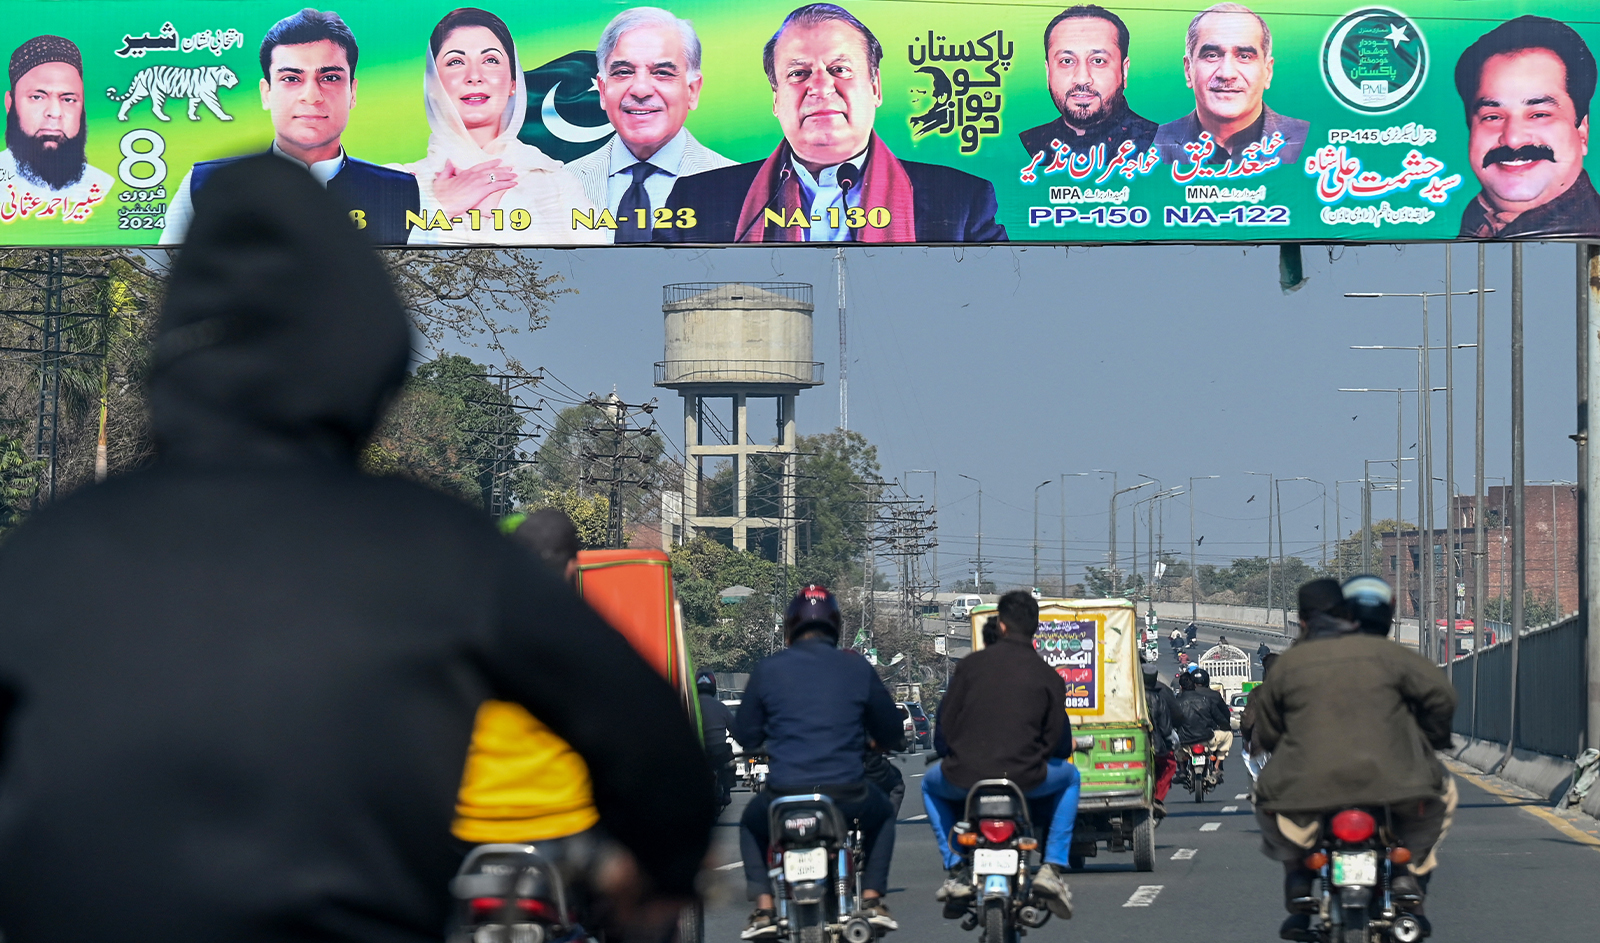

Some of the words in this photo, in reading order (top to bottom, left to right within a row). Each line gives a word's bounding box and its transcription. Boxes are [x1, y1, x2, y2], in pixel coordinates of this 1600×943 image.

[115, 22, 178, 56] شیر
[182, 30, 211, 51] نشان
[210, 29, 243, 55] انتخابی
[907, 30, 1014, 71] پاکستان
[952, 59, 1001, 97] کو
[1350, 65, 1397, 81] پاکستان
[961, 114, 1000, 153] دو
[1330, 131, 1379, 141] PP-145
[1172, 132, 1232, 182] رفیق
[1242, 132, 1284, 159] خواجہ
[118, 128, 168, 189] 8
[1020, 139, 1070, 182] نذیر
[1069, 140, 1135, 183] عمران
[1119, 147, 1160, 178] خواجہ
[1228, 157, 1280, 177] سعد
[1307, 148, 1339, 171] شاہ
[1320, 149, 1357, 199] علی
[1351, 152, 1440, 193] حشمت
[118, 185, 166, 202] فروری
[1050, 188, 1082, 200] MPA
[1187, 187, 1219, 199] MNA
[1422, 177, 1458, 200] سید
[1, 183, 42, 220] عثمانی
[37, 196, 68, 216] احمد
[65, 183, 103, 220] شبیر
[118, 203, 166, 217] الیکشن
[118, 216, 165, 229] 2024
[404, 208, 532, 231] NA-119
[571, 207, 699, 230] NA-123
[763, 206, 892, 229] NA-130
[1029, 207, 1149, 224] PP-150
[1165, 206, 1288, 224] NA-122
[1047, 650, 1092, 668] الیکشن
